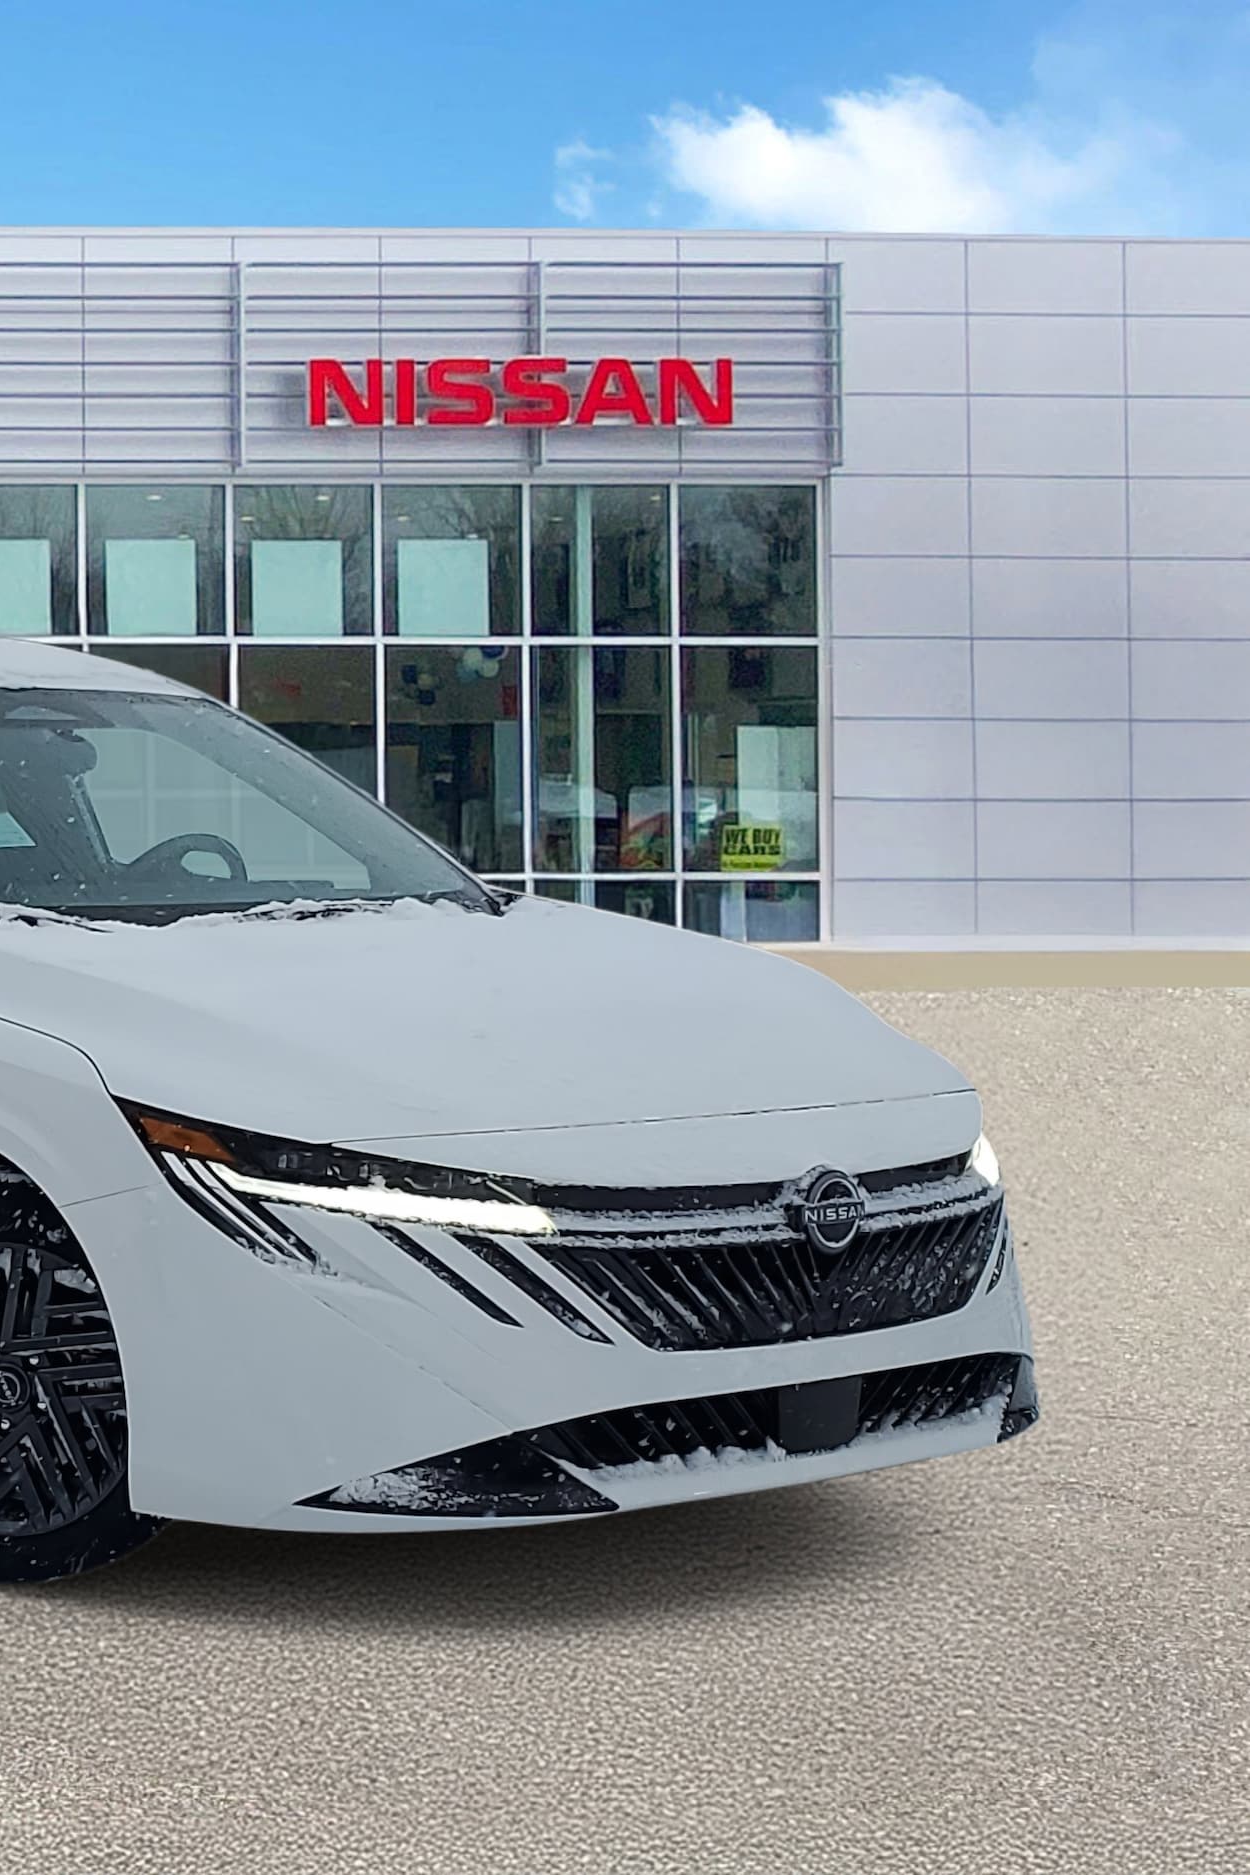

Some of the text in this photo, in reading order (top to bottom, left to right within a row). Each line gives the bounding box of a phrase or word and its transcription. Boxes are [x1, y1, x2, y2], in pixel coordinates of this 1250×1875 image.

[308, 358, 733, 427] NISSAN
[725, 828, 781, 844] WE BUY
[723, 844, 781, 855] CARS
[805, 1204, 865, 1223] NISSAN
